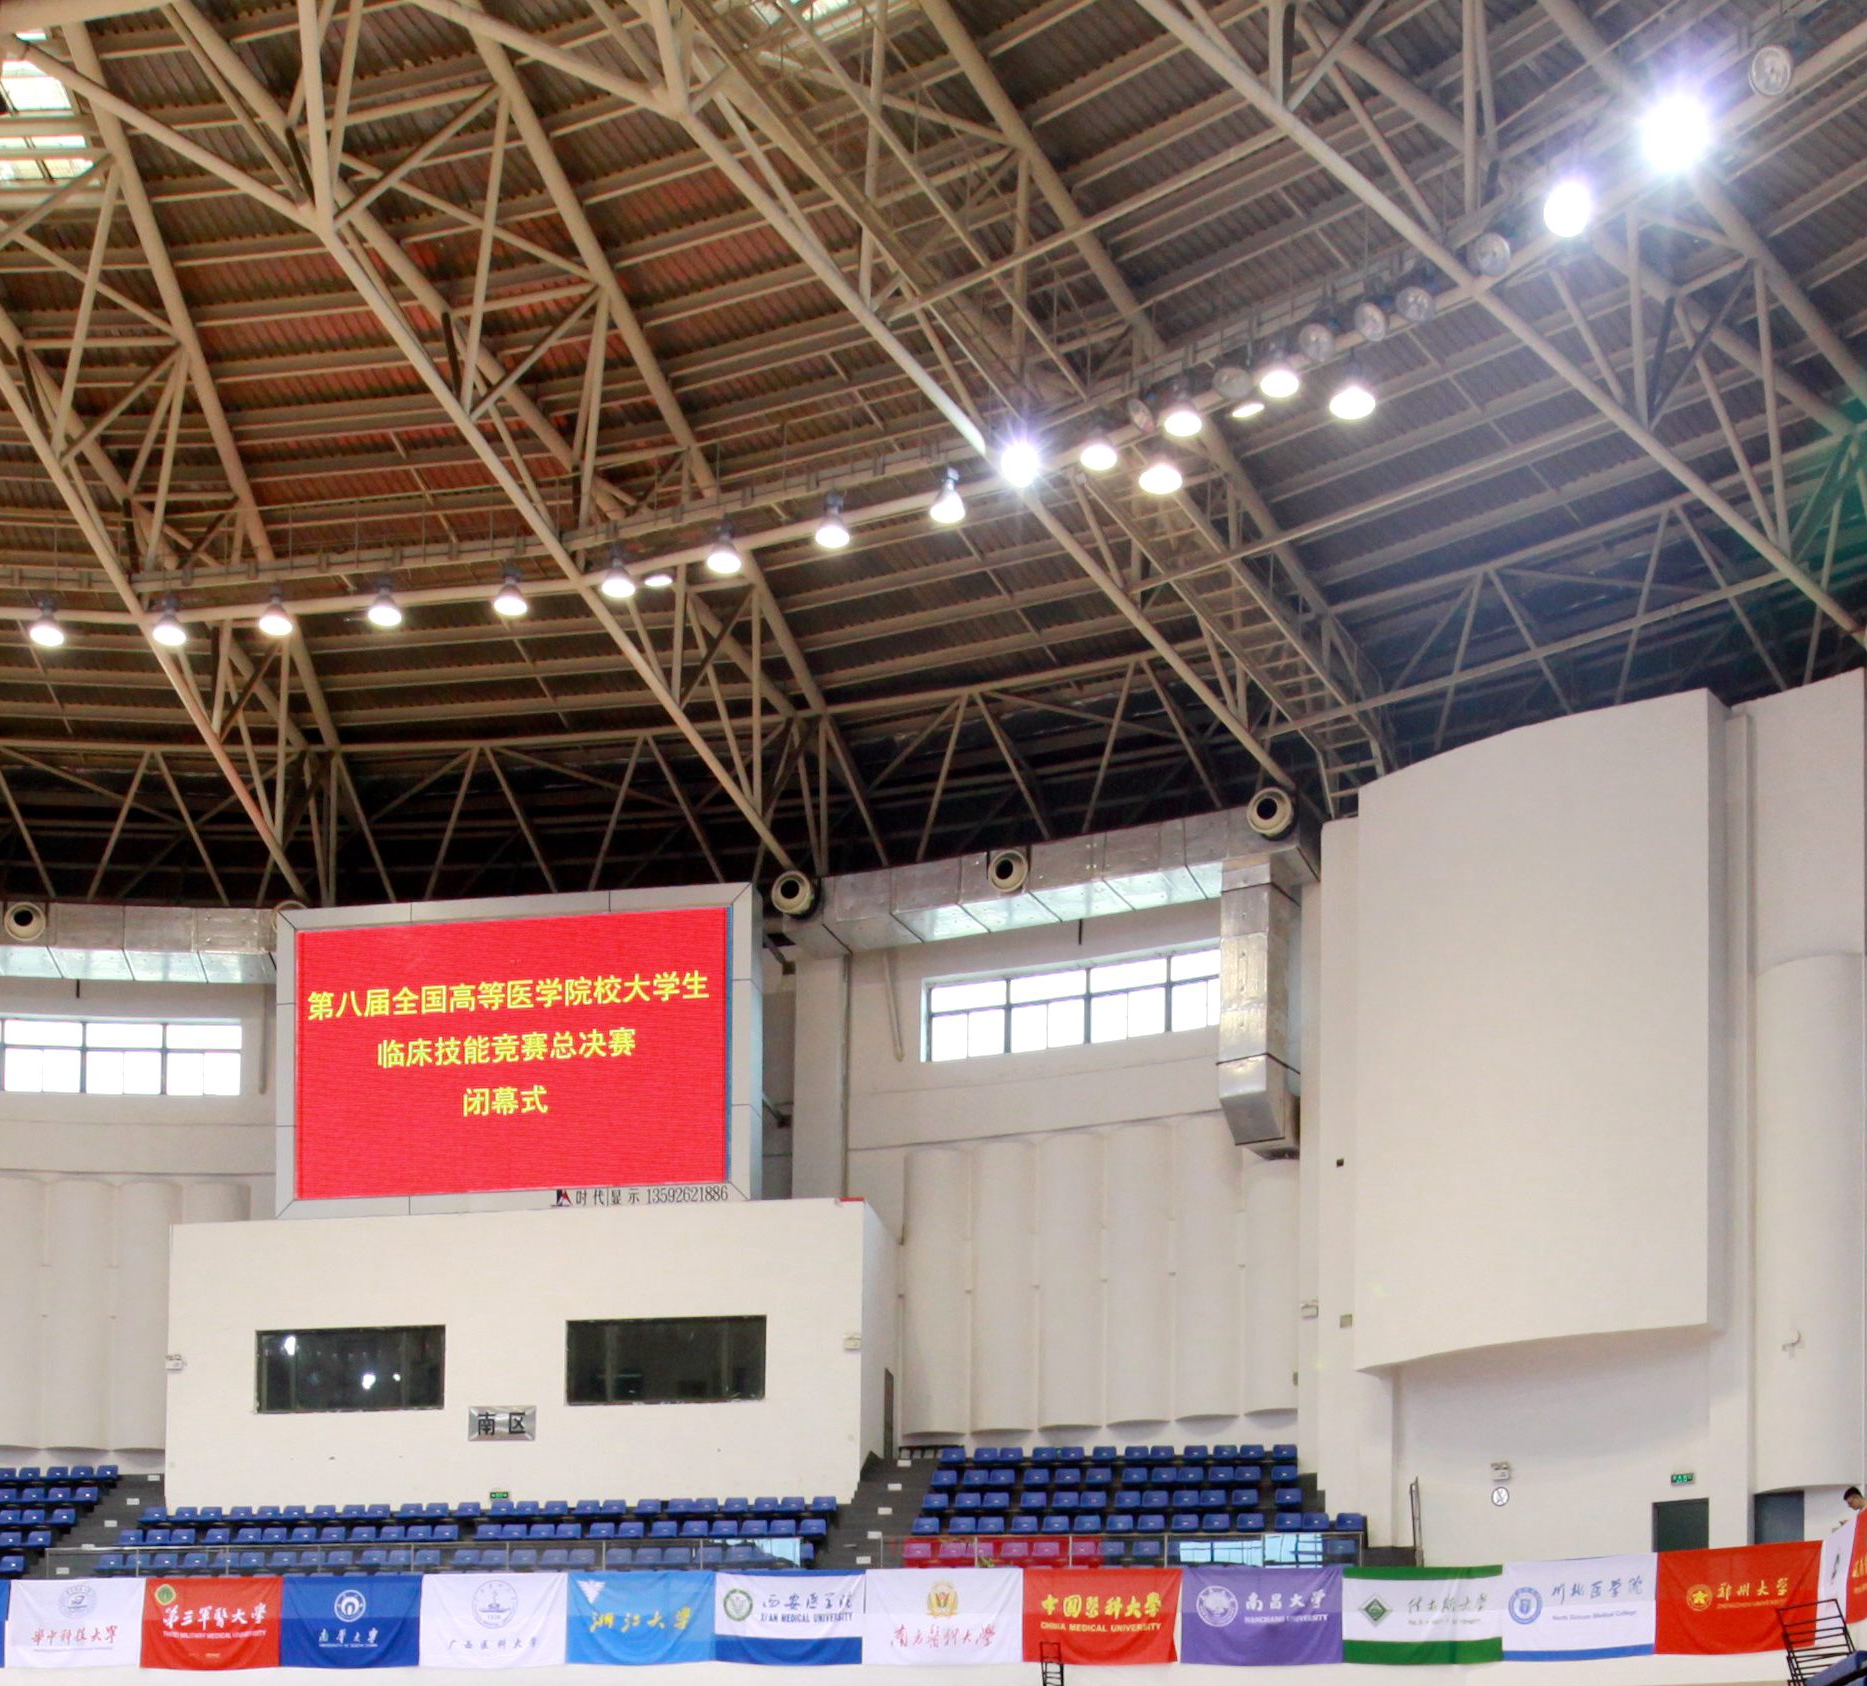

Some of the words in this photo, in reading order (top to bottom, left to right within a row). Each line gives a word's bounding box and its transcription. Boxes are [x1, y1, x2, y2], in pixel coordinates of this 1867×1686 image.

[307, 970, 710, 1021] 第八届全国高等医学院校大学生
[377, 1028, 636, 1069] 临床技能竞赛总决赛
[462, 1085, 548, 1117] 闭幕式
[1068, 1622, 1108, 1633] MEDICAL
[1110, 1621, 1162, 1633] UNIVERSITY
